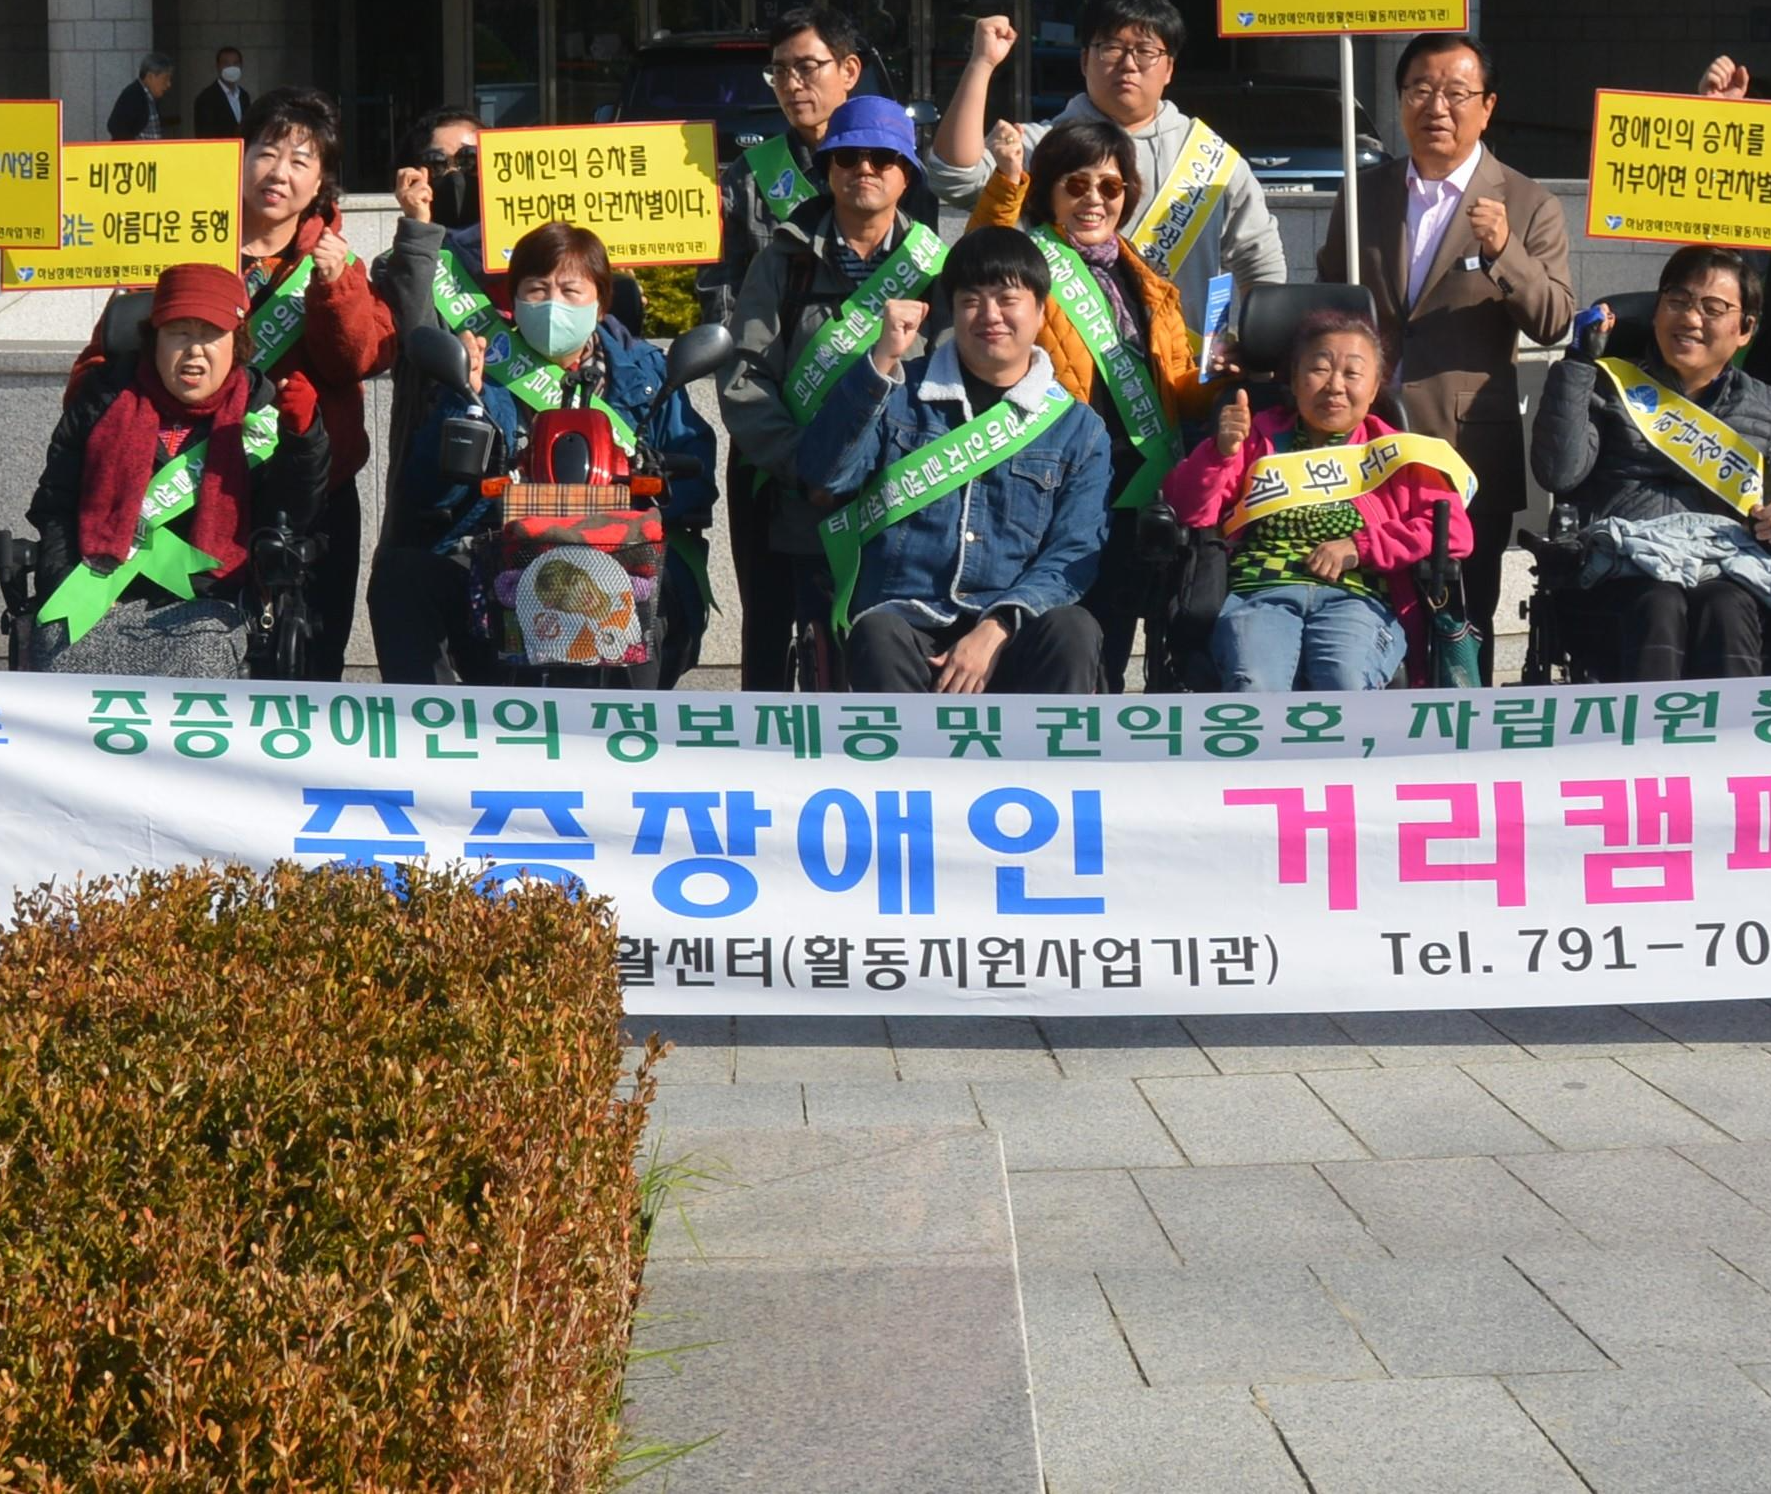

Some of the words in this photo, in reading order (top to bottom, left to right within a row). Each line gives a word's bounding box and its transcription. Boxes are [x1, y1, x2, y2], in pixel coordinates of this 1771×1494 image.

[1609, 115, 1693, 151] 장애인의
[1703, 121, 1765, 157] 승차를
[89, 161, 158, 195] 비장애
[492, 150, 578, 183] 장애인의
[586, 145, 647, 178] 승차를
[1606, 161, 1686, 198] 거부하면
[102, 209, 180, 245] 아름다운
[191, 209, 230, 243] 동행
[495, 192, 577, 228] 거부하면
[585, 189, 711, 223] 인권차별이다.
[89, 689, 559, 761] 중증장애인의
[592, 702, 900, 763] 정보제공
[936, 703, 1004, 759] 및
[1037, 702, 1375, 761] 권익옹호,
[1410, 689, 1721, 752] 자립지원
[1381, 932, 1495, 978] Tel.
